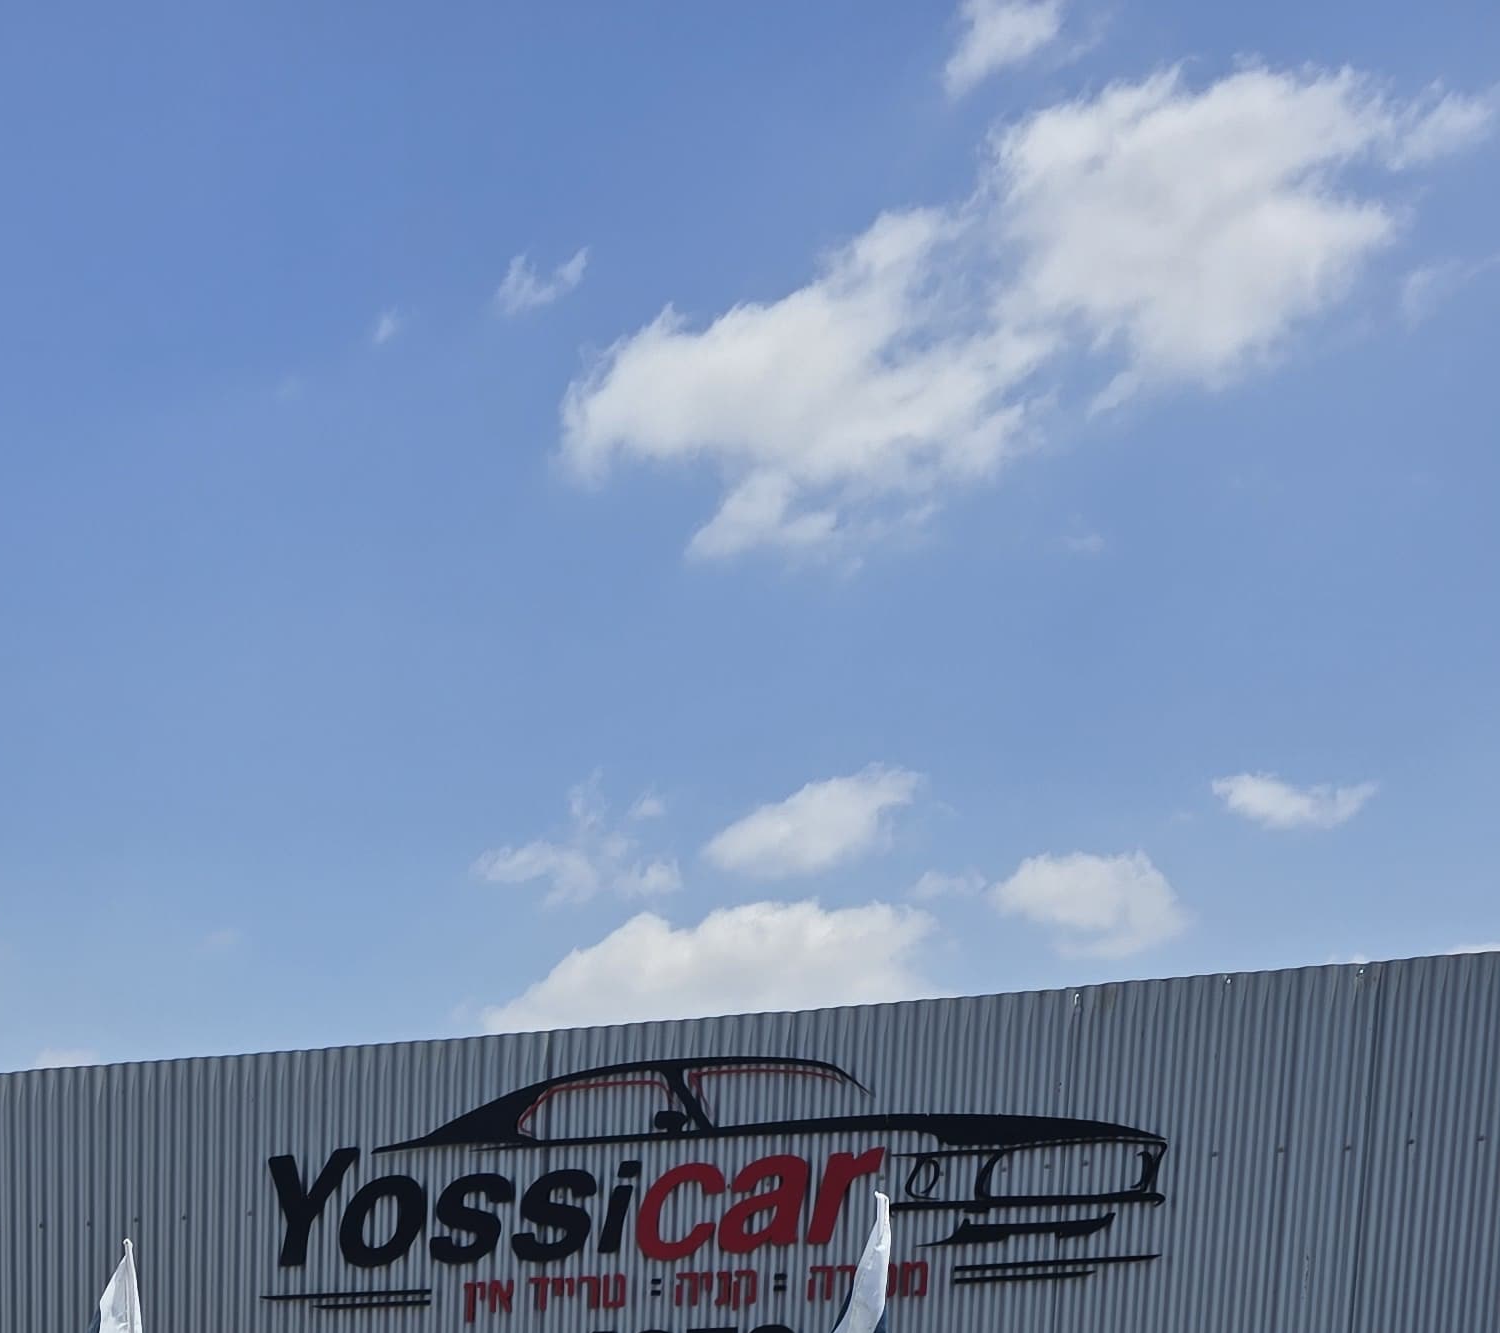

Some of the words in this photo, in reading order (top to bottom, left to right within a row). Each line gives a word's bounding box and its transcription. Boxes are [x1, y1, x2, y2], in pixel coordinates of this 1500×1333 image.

[463, 1279, 514, 1323] אין
[529, 1273, 626, 1313] טרייד
[675, 1269, 757, 1311] קניה
